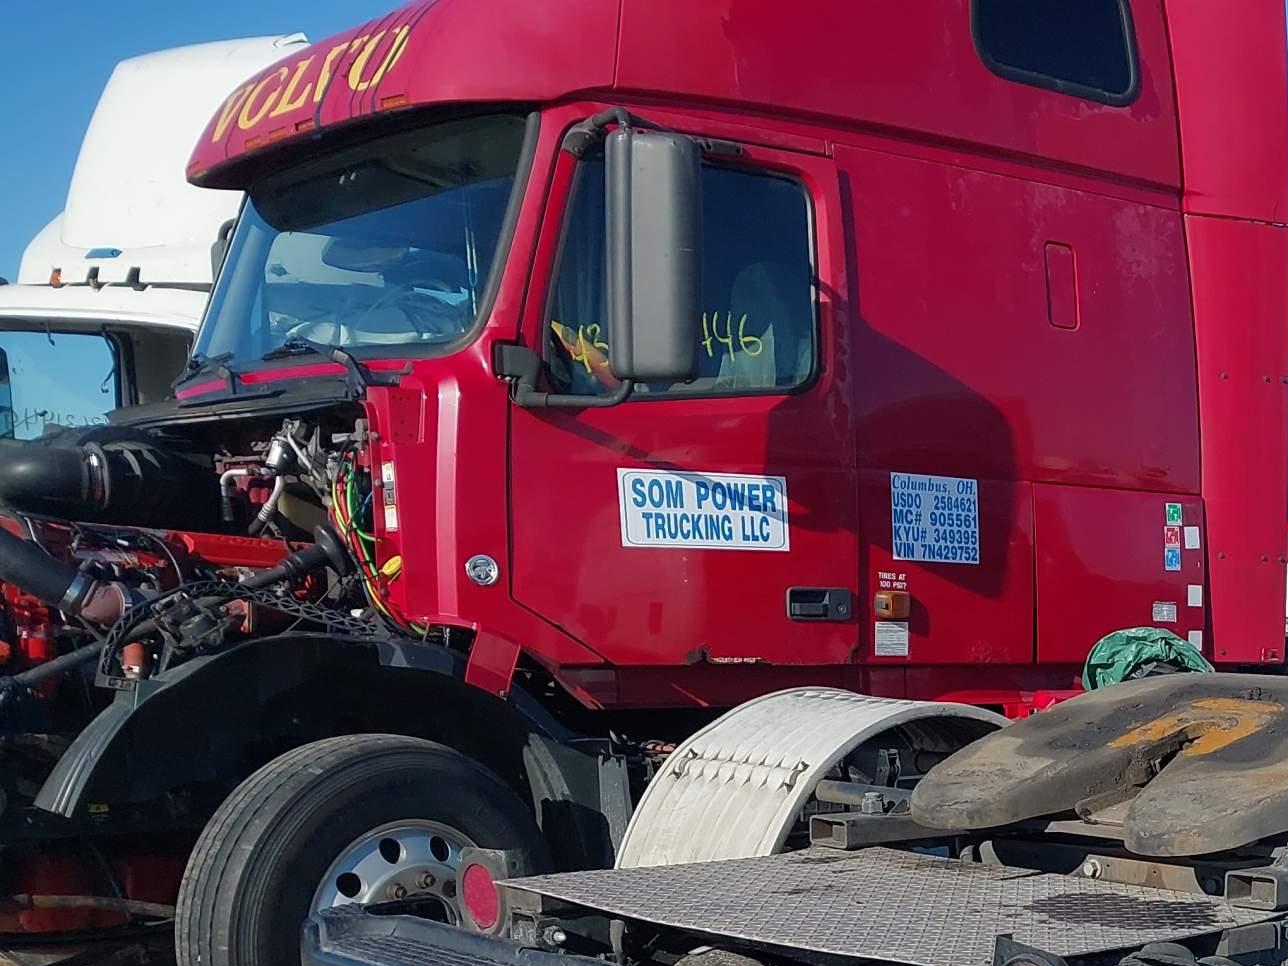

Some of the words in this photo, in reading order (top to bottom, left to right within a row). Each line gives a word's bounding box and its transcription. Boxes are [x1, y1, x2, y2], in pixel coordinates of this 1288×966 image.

[892, 474, 951, 494] Columbus,
[631, 478, 685, 509] SOM
[695, 481, 777, 513] POWER
[934, 495, 977, 514] 2584621
[642, 512, 734, 542] TRUCKING
[741, 515, 771, 543] LLC
[893, 508, 922, 526] MC#
[930, 511, 977, 530] 905561
[894, 525, 927, 544] KYU#
[934, 528, 977, 546] 349395
[895, 542, 915, 559] VIN
[921, 543, 978, 562] 7N429752
